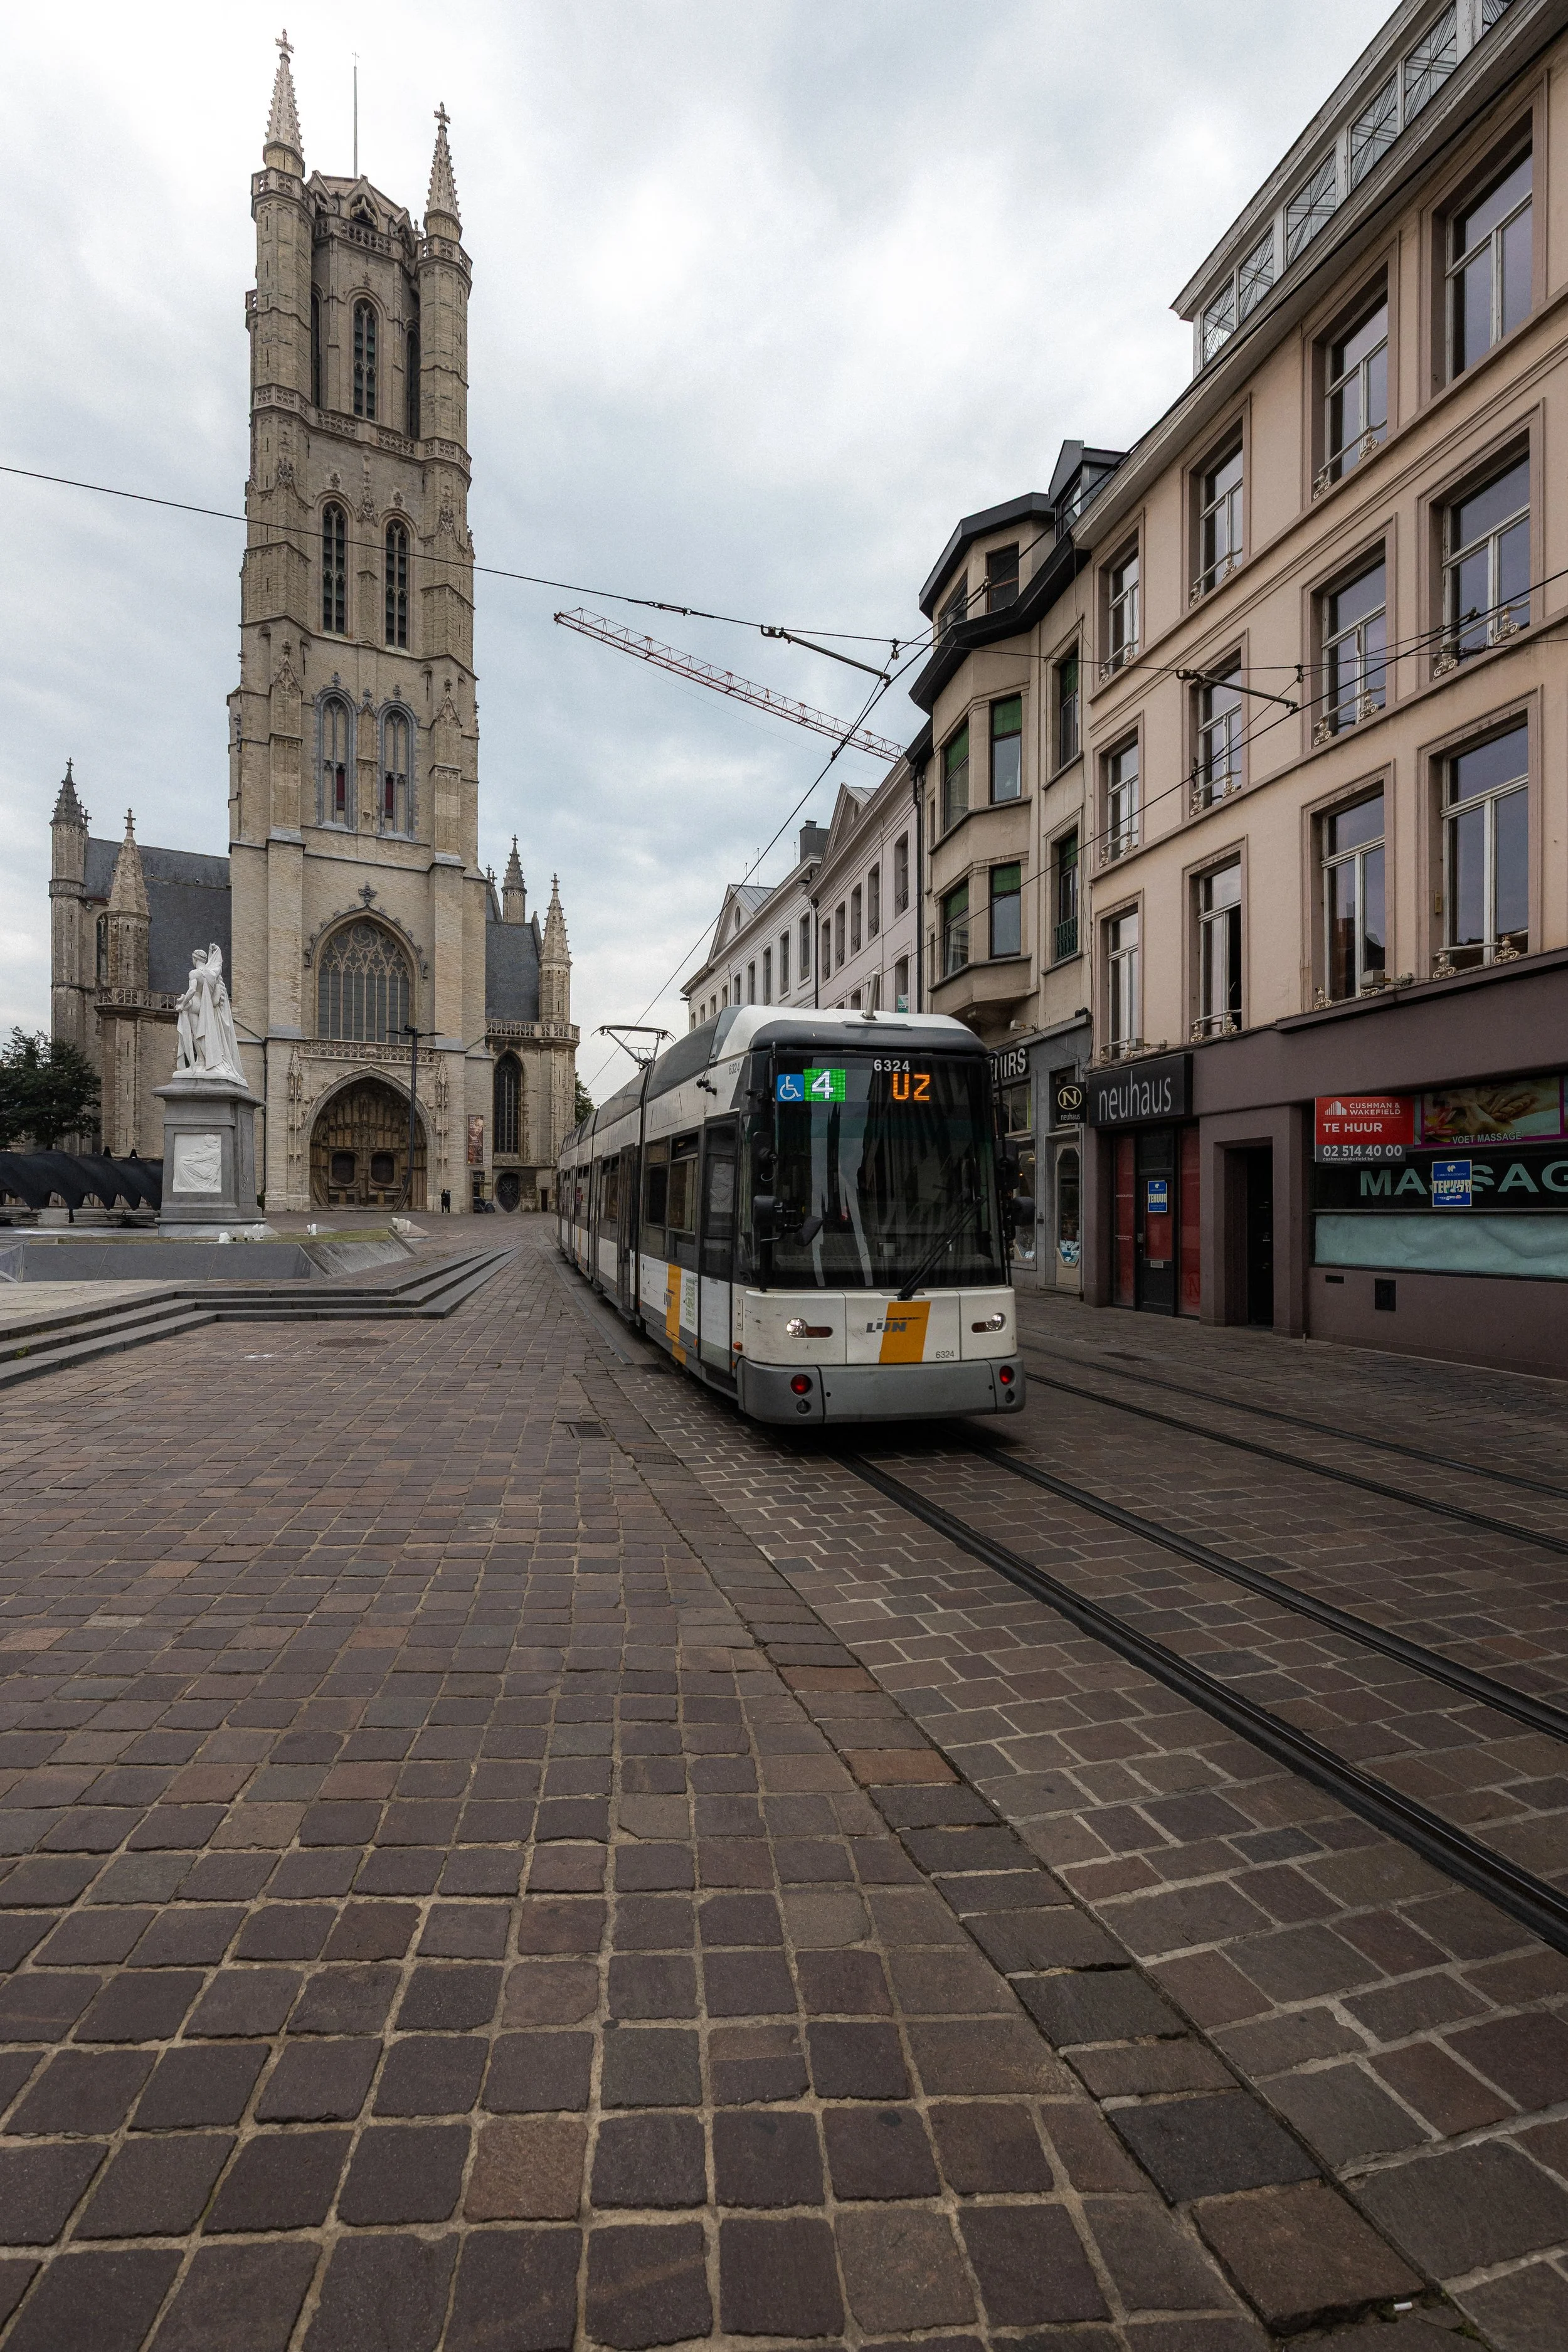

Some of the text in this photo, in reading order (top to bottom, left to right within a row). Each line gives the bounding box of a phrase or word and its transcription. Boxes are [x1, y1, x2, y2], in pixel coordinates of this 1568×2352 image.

[728, 1062, 741, 1075] 6324
[874, 1059, 910, 1072] 6324
[812, 1070, 834, 1099] 4
[893, 1073, 930, 1101] UZ
[1062, 1090, 1078, 1106] N
[1099, 1070, 1172, 1121] neuhaus
[1061, 1113, 1081, 1121] neuhaus
[1323, 1123, 1383, 1133] TE HUUR
[1452, 1131, 1522, 1145] VOET MASSAGE
[1323, 1145, 1402, 1157] 02 514 40 00
[935, 1350, 955, 1359] 6324
